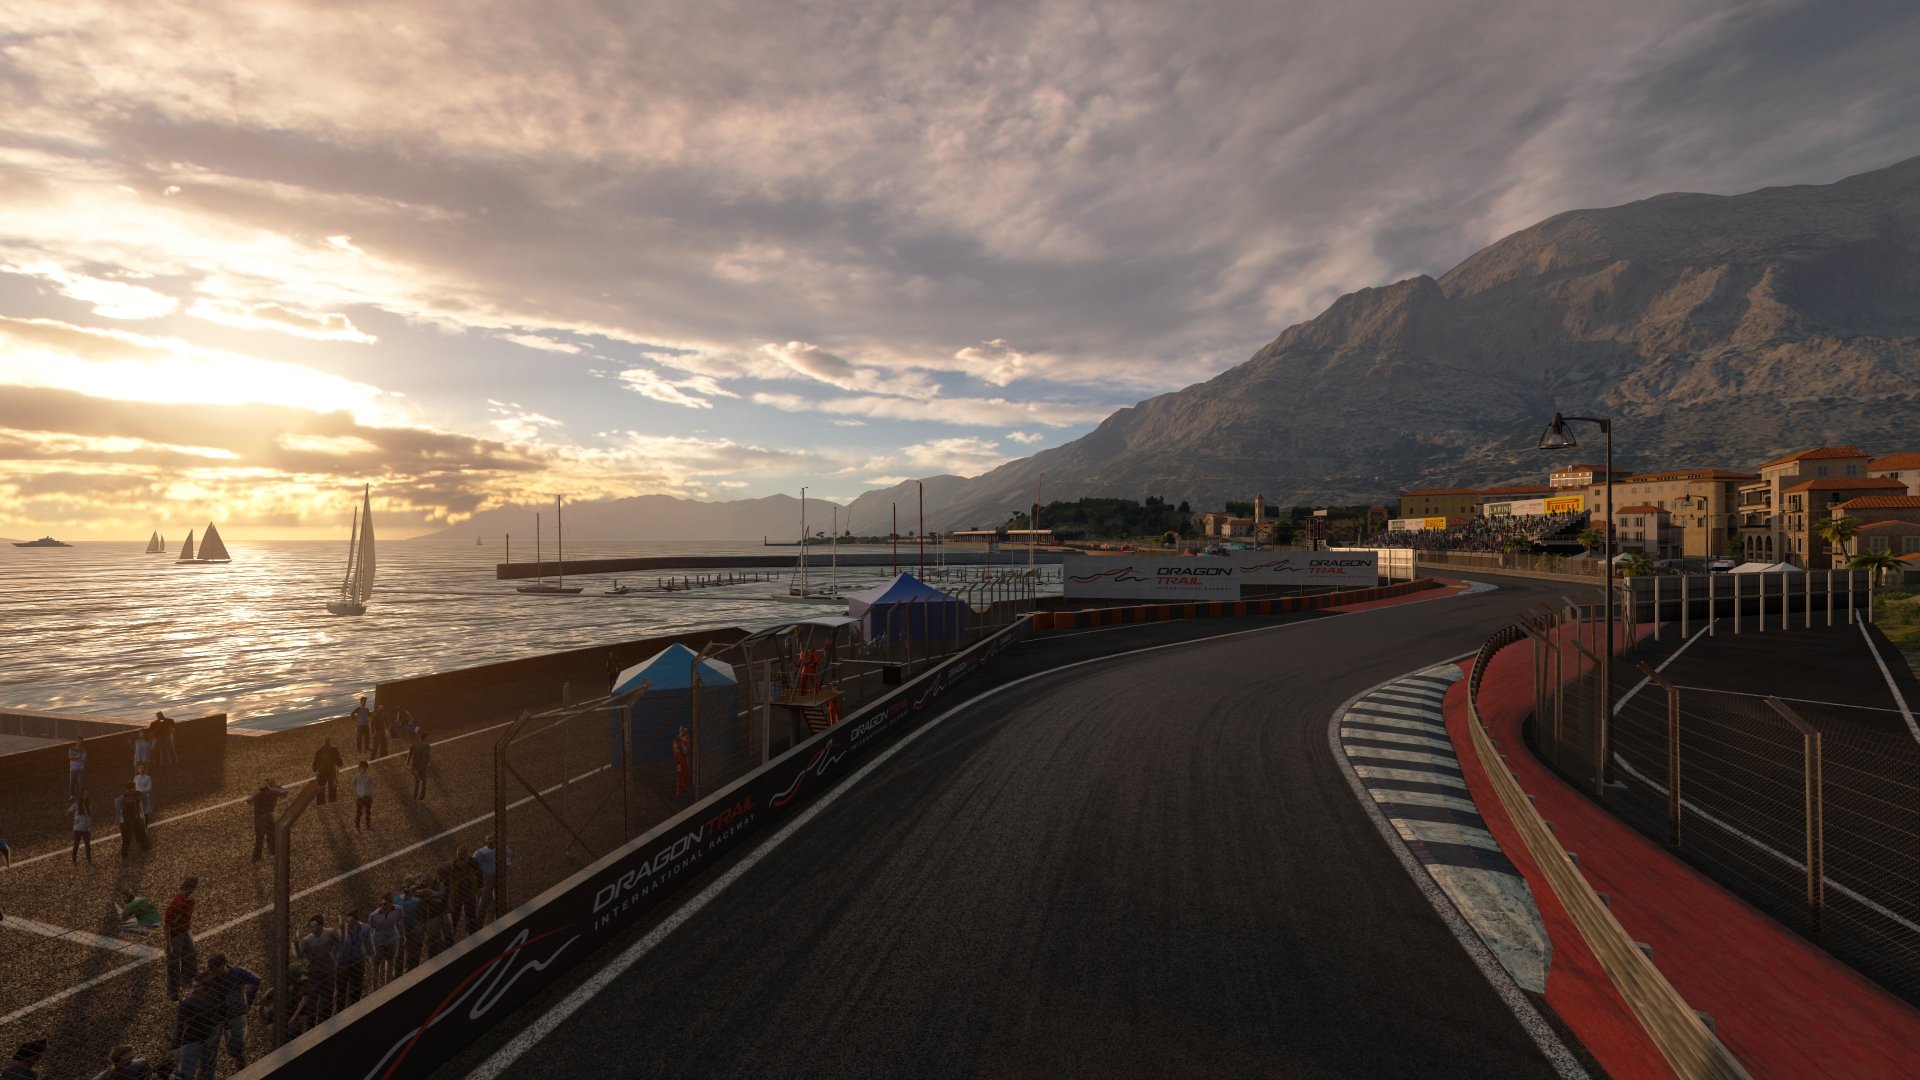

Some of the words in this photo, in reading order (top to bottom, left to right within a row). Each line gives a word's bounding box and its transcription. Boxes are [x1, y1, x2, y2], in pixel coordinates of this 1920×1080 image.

[1547, 498, 1580, 511] PIRELLI
[1309, 559, 1372, 567] DRAGON
[1157, 567, 1232, 576] DRAGON
[1155, 576, 1203, 585] TRAIL
[850, 708, 889, 742] DRAGON
[592, 825, 704, 914] DRAGON
[705, 796, 756, 835] TRAIL
[594, 849, 703, 931] INTERNATIONAL
[709, 813, 756, 849] RACEWAY
